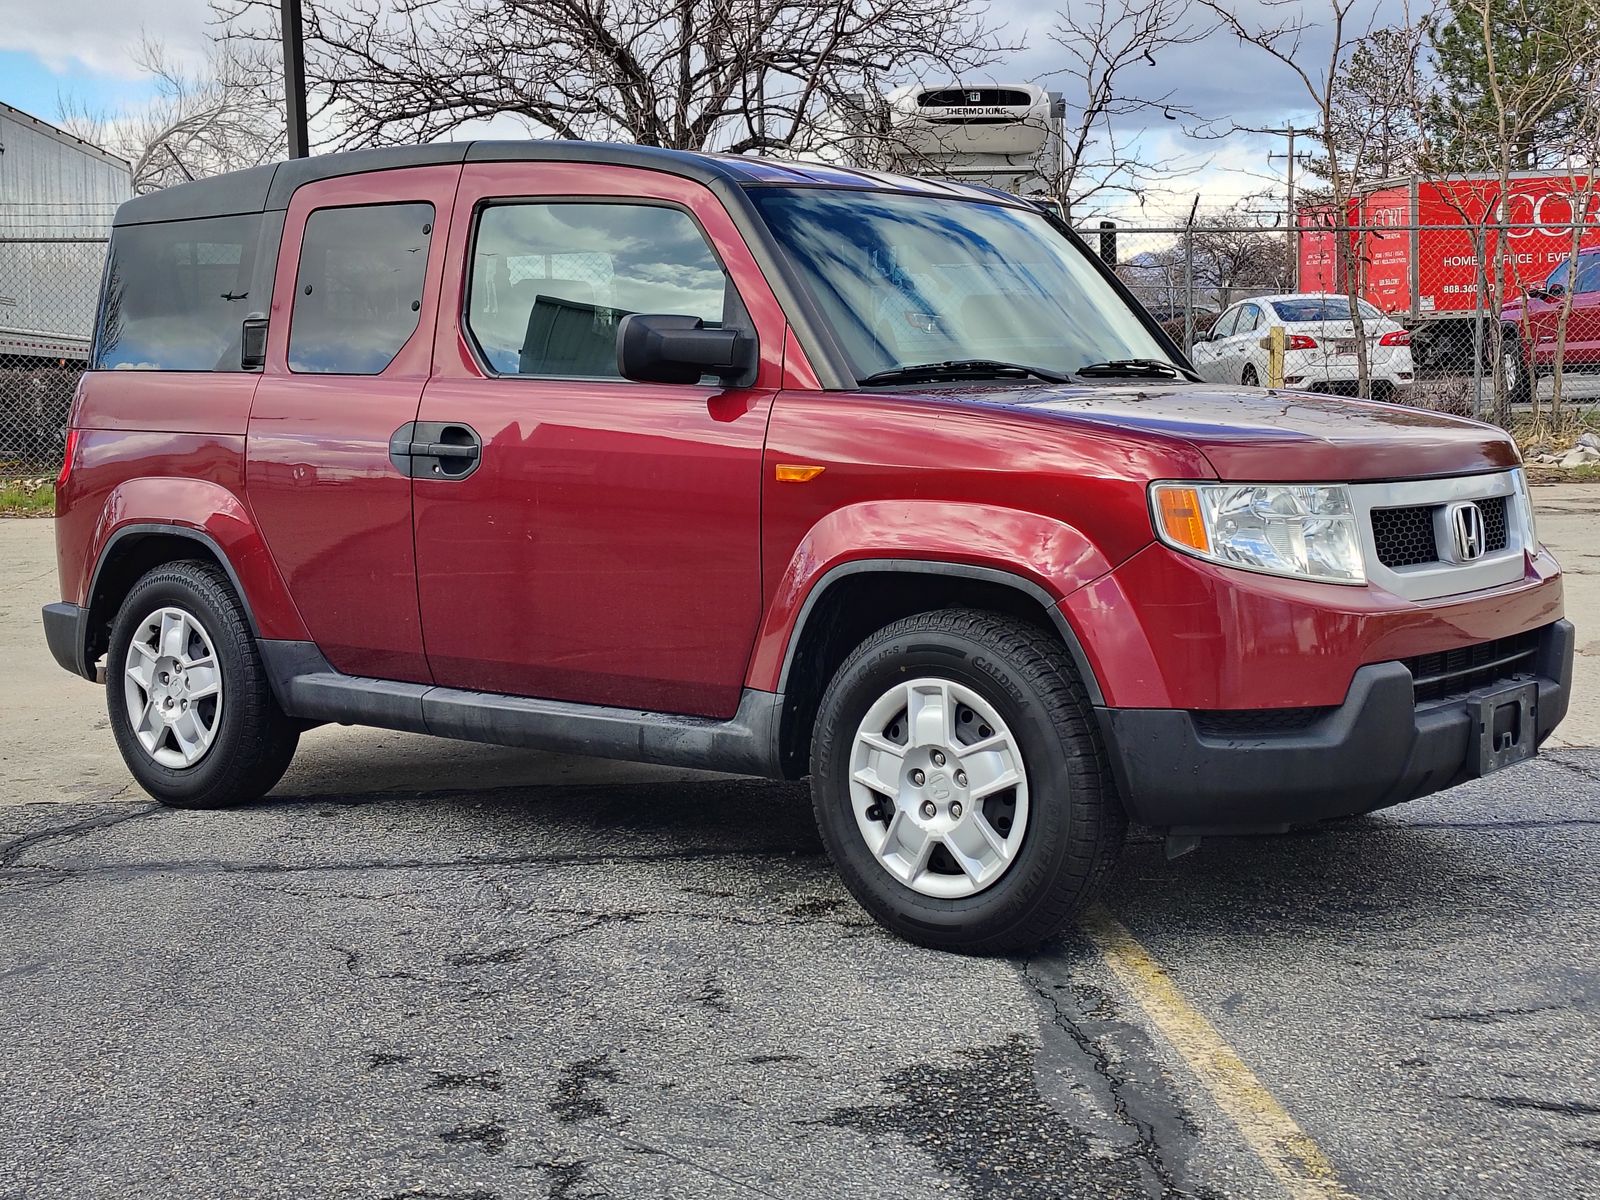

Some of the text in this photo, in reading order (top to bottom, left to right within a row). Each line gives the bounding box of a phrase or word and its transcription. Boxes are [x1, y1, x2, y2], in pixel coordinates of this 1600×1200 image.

[945, 107, 1007, 115] THERMO KING
[1444, 255, 1478, 267] HOME
[1547, 251, 1572, 264] EVE
